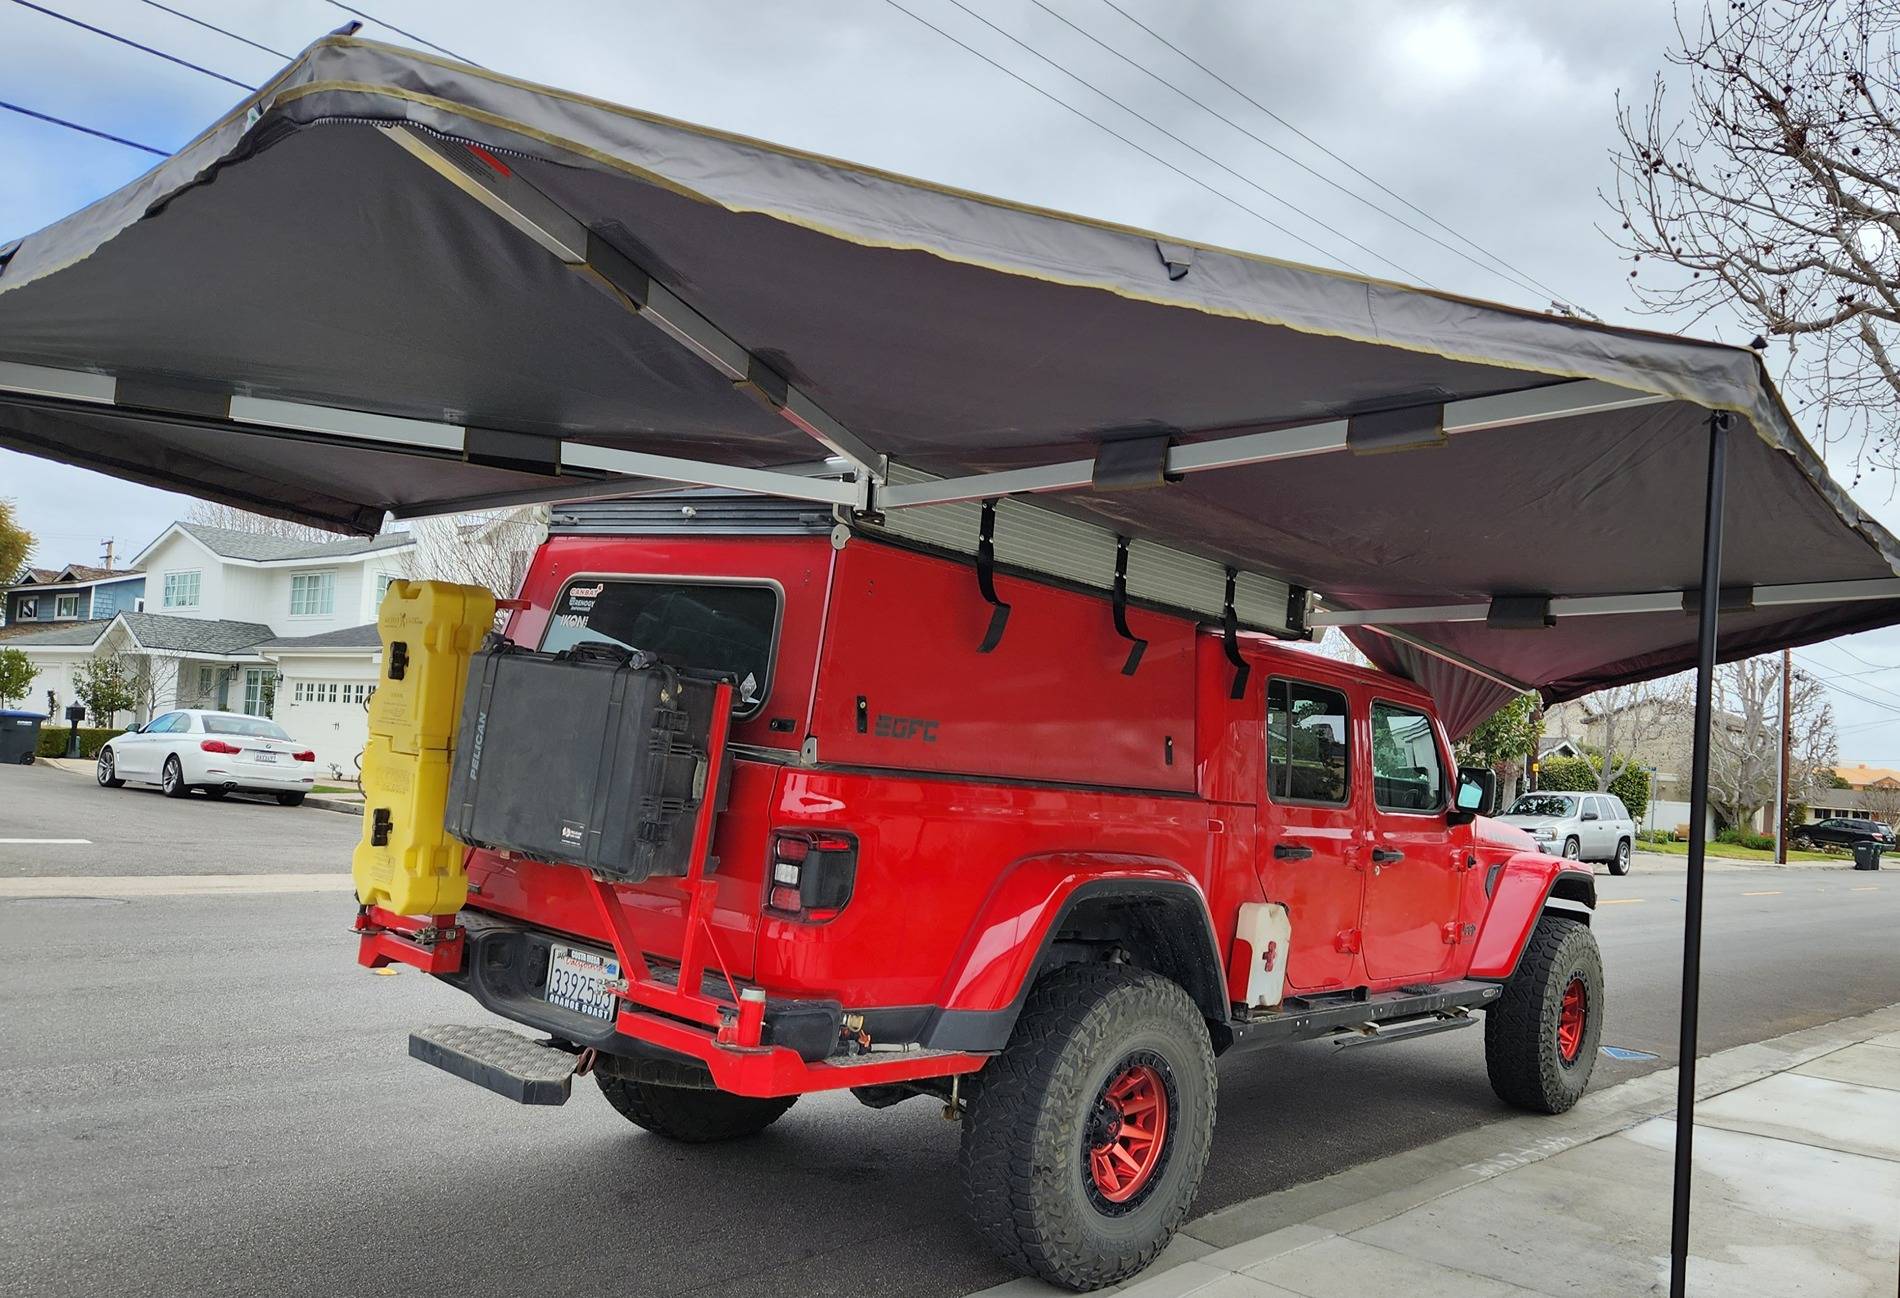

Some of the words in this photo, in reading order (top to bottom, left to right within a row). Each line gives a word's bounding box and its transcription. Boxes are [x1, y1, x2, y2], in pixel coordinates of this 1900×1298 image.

[571, 588, 598, 596] CANBAT
[470, 712, 486, 780] PELICAN
[549, 993, 580, 1011] ORANGE
[581, 1004, 609, 1020] COAST
